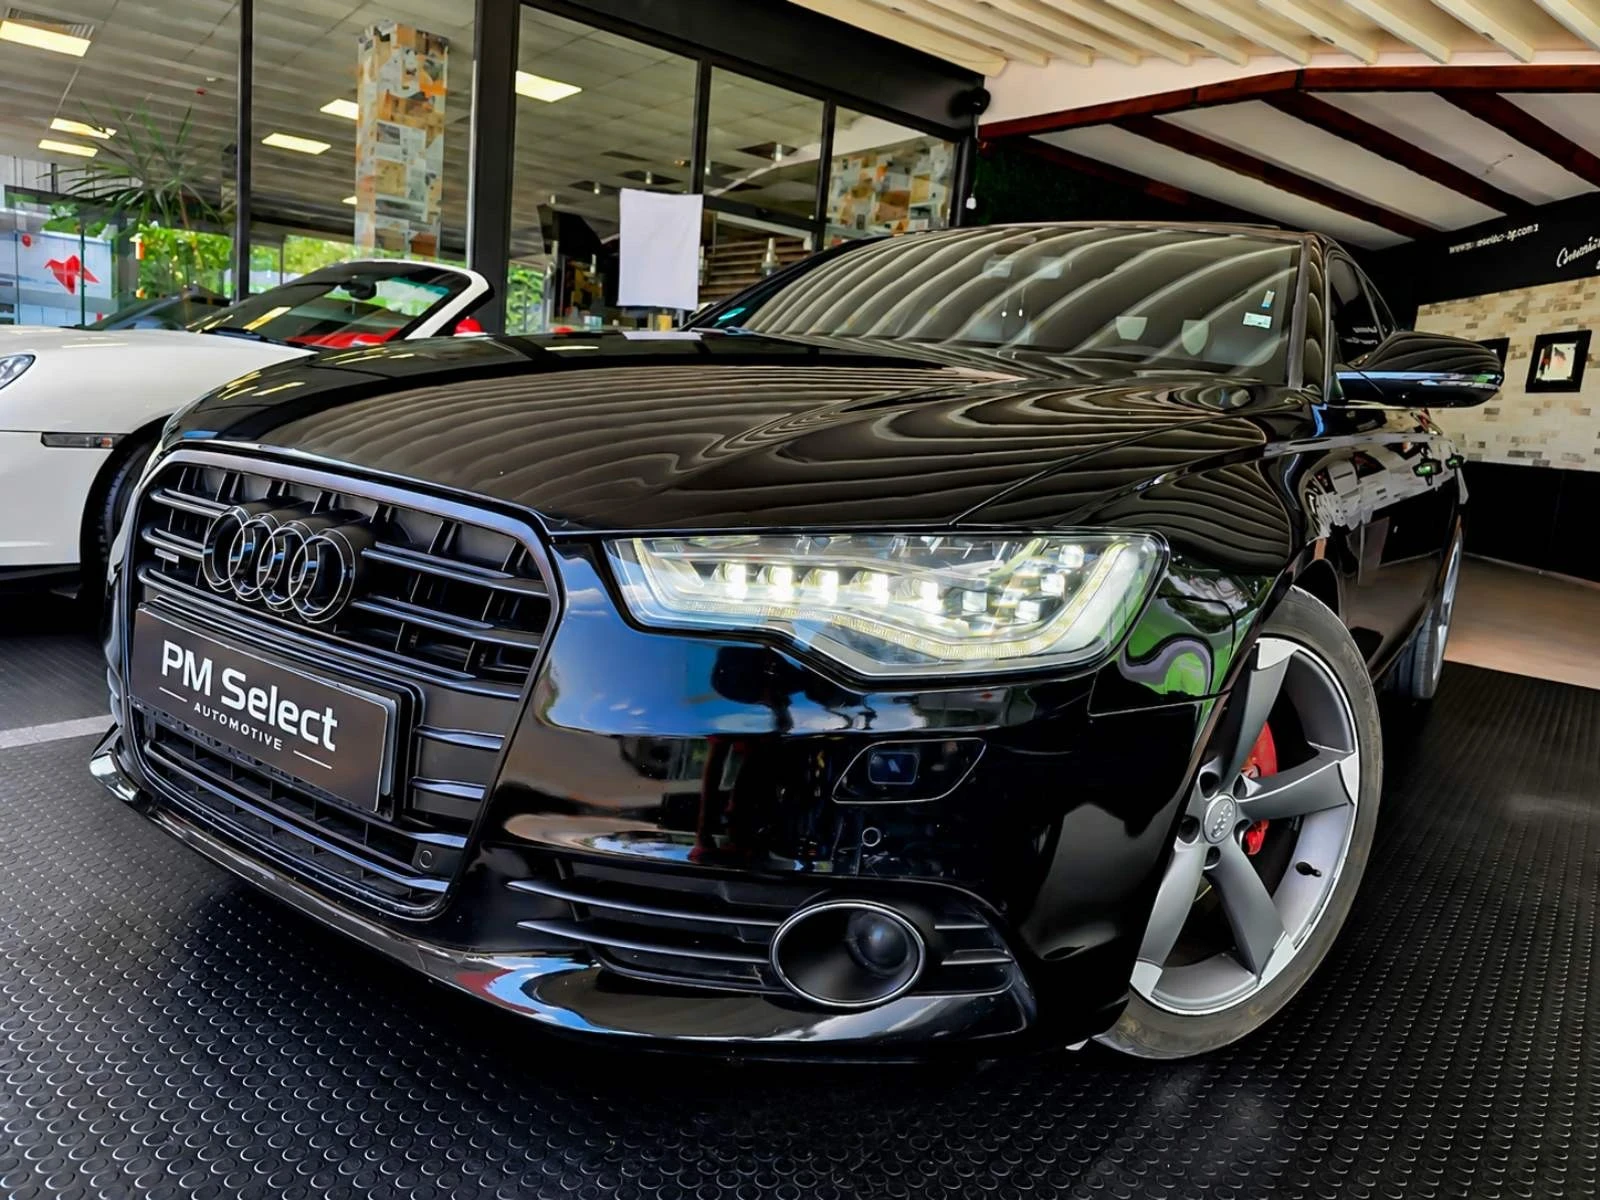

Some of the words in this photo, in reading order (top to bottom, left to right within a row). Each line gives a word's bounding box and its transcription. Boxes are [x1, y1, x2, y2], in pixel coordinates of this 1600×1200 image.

[161, 639, 213, 697] PM
[220, 667, 338, 752] Select
[193, 702, 283, 751] AUTOMOTIVE
